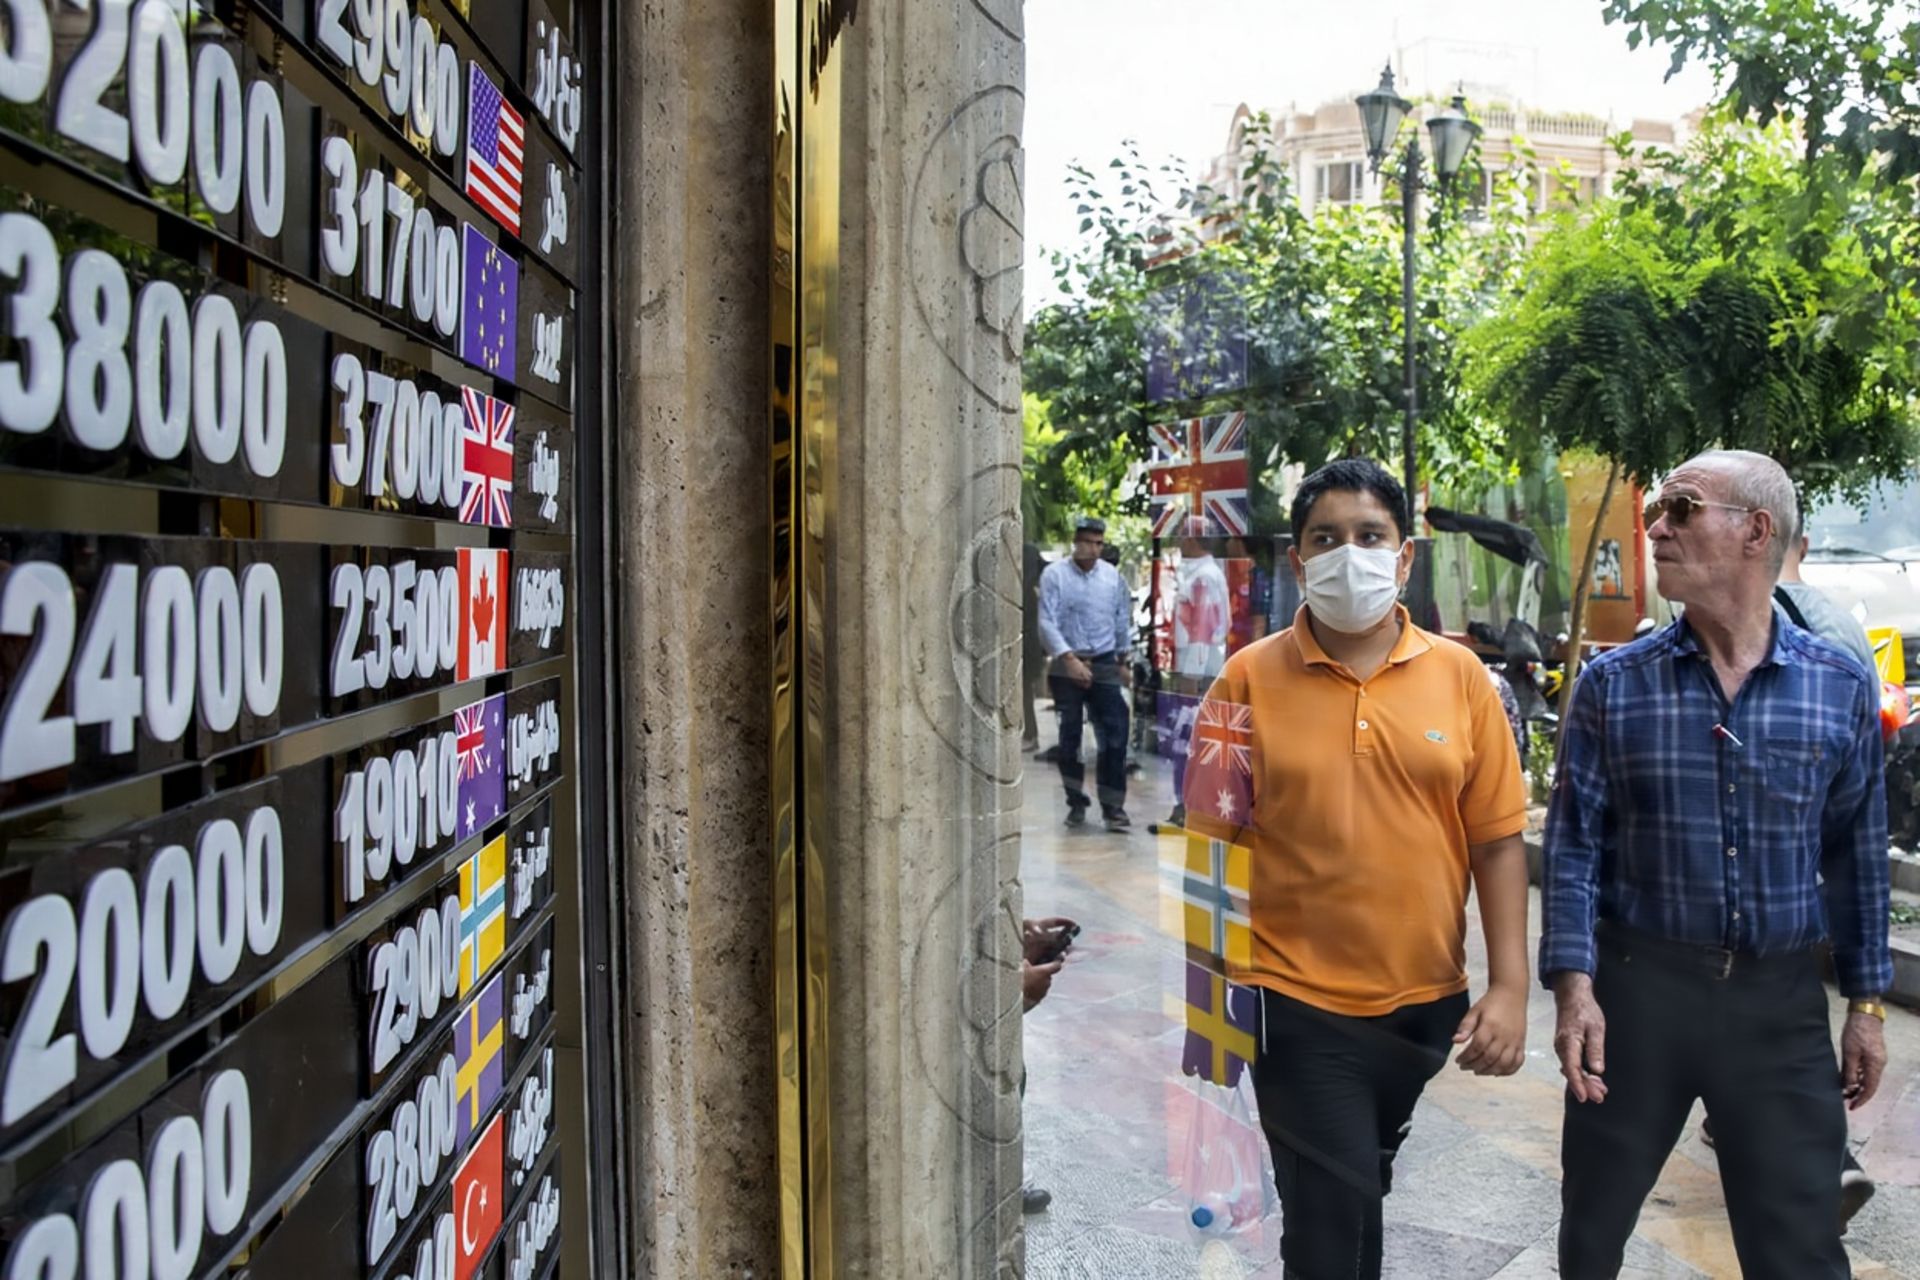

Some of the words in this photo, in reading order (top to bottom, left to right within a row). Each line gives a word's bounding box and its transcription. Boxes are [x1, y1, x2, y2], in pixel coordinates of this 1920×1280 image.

[321, 137, 459, 338] 31700
[539, 161, 568, 255] دلار
[0, 213, 287, 477] 38000
[331, 354, 462, 508] 37000
[0, 561, 284, 781] 24000
[331, 560, 458, 698] 23500
[336, 732, 457, 902] 19010
[2, 806, 283, 1126] 20000
[368, 895, 461, 1074] 2900
[367, 1053, 457, 1267] 2800
